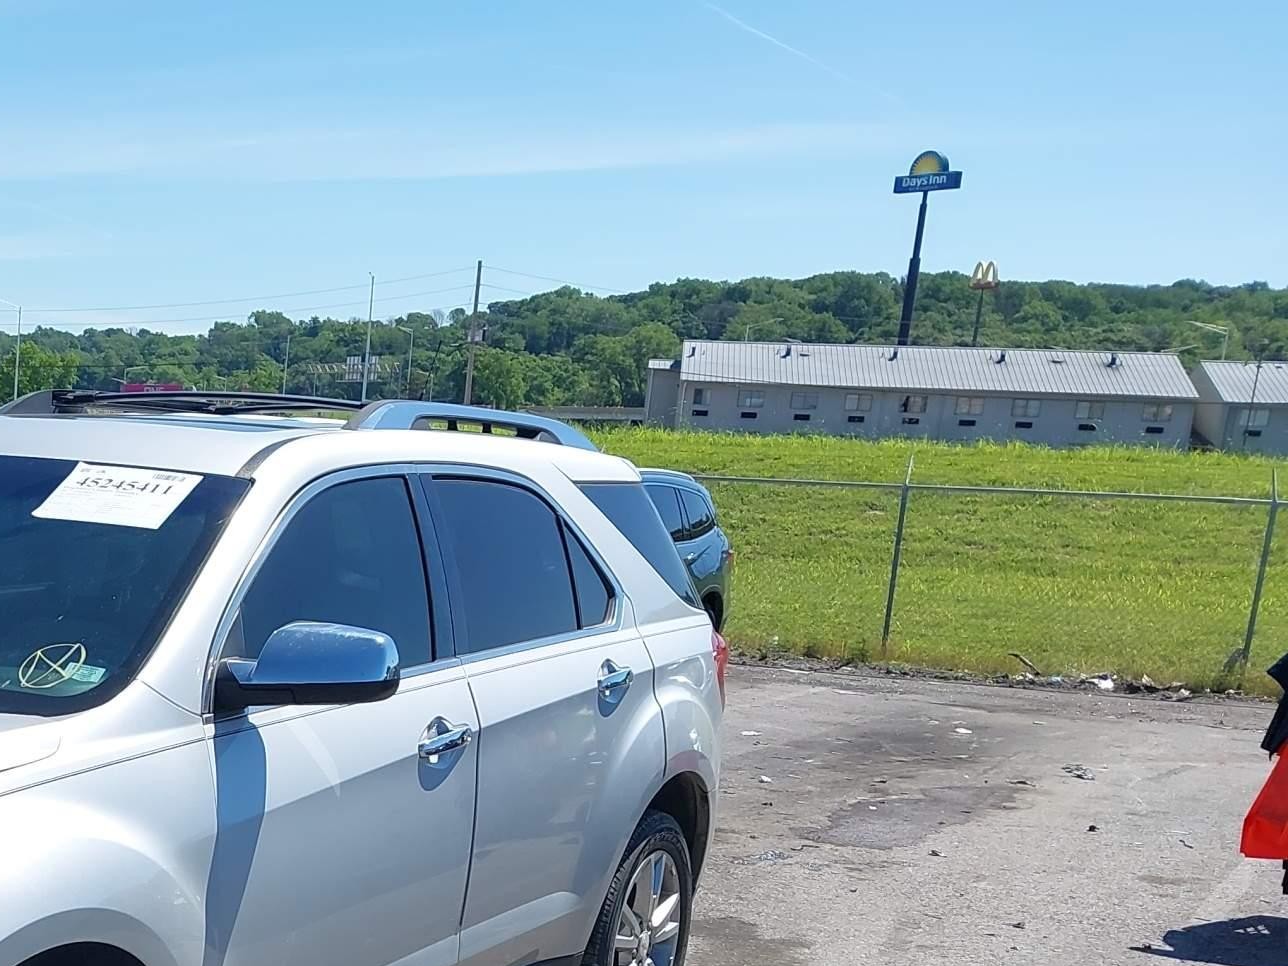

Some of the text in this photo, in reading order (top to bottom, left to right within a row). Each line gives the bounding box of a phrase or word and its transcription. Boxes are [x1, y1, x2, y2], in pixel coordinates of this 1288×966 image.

[902, 175, 947, 187] Days Inn
[76, 476, 174, 495] 45245411
